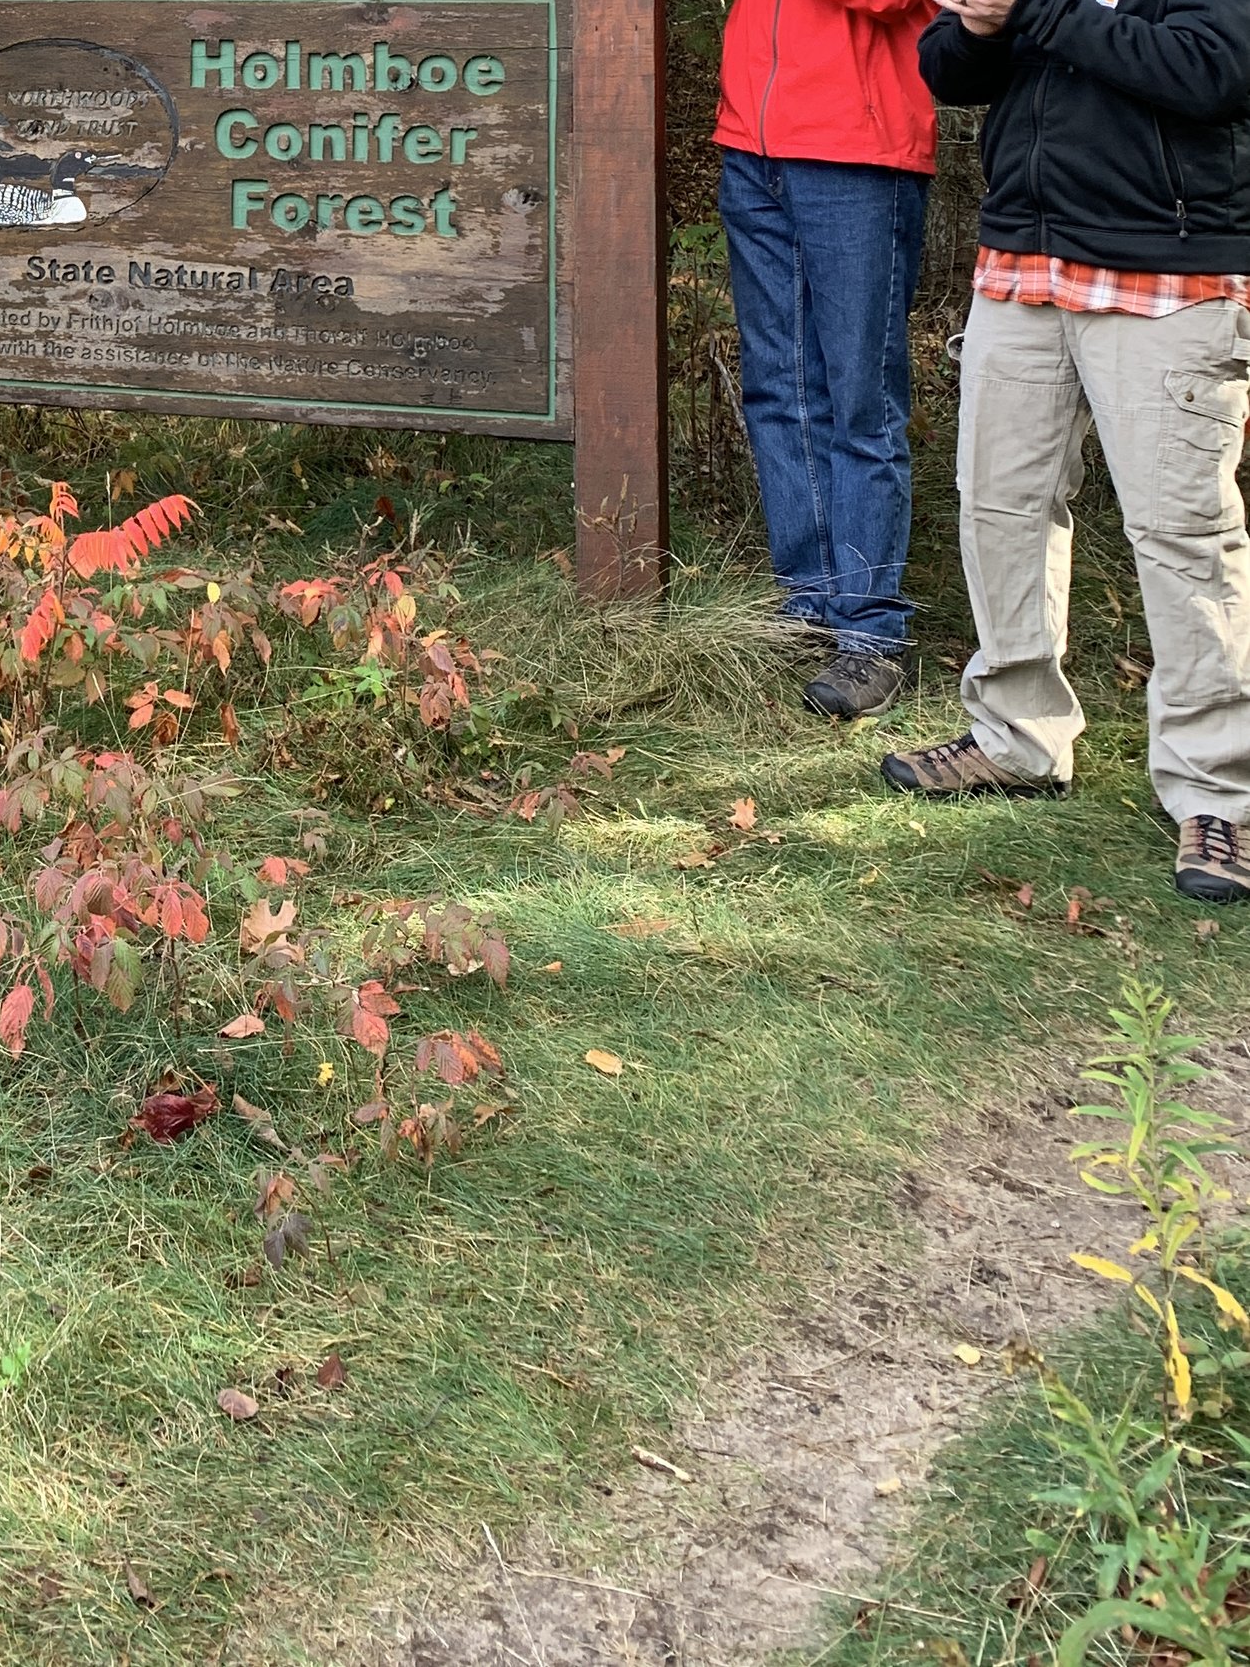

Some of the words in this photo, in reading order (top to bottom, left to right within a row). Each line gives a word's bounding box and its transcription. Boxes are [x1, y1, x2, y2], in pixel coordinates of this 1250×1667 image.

[191, 39, 506, 96] Holmboe
[6, 88, 149, 108] NORTHWOODS
[76, 120, 138, 137] TRUST
[215, 108, 478, 165] Conifer
[232, 179, 458, 238] Forest
[26, 255, 116, 285] State
[128, 261, 257, 291] Natural
[269, 268, 355, 296] Area
[38, 313, 61, 332] by
[66, 313, 141, 335] Frithjof
[148, 316, 241, 338] Holmboe
[247, 322, 287, 340] and
[376, 330, 477, 352] Holmboe
[42, 340, 75, 359] the
[81, 345, 189, 367] assistance
[199, 349, 219, 367] of
[269, 355, 339, 375] Nature
